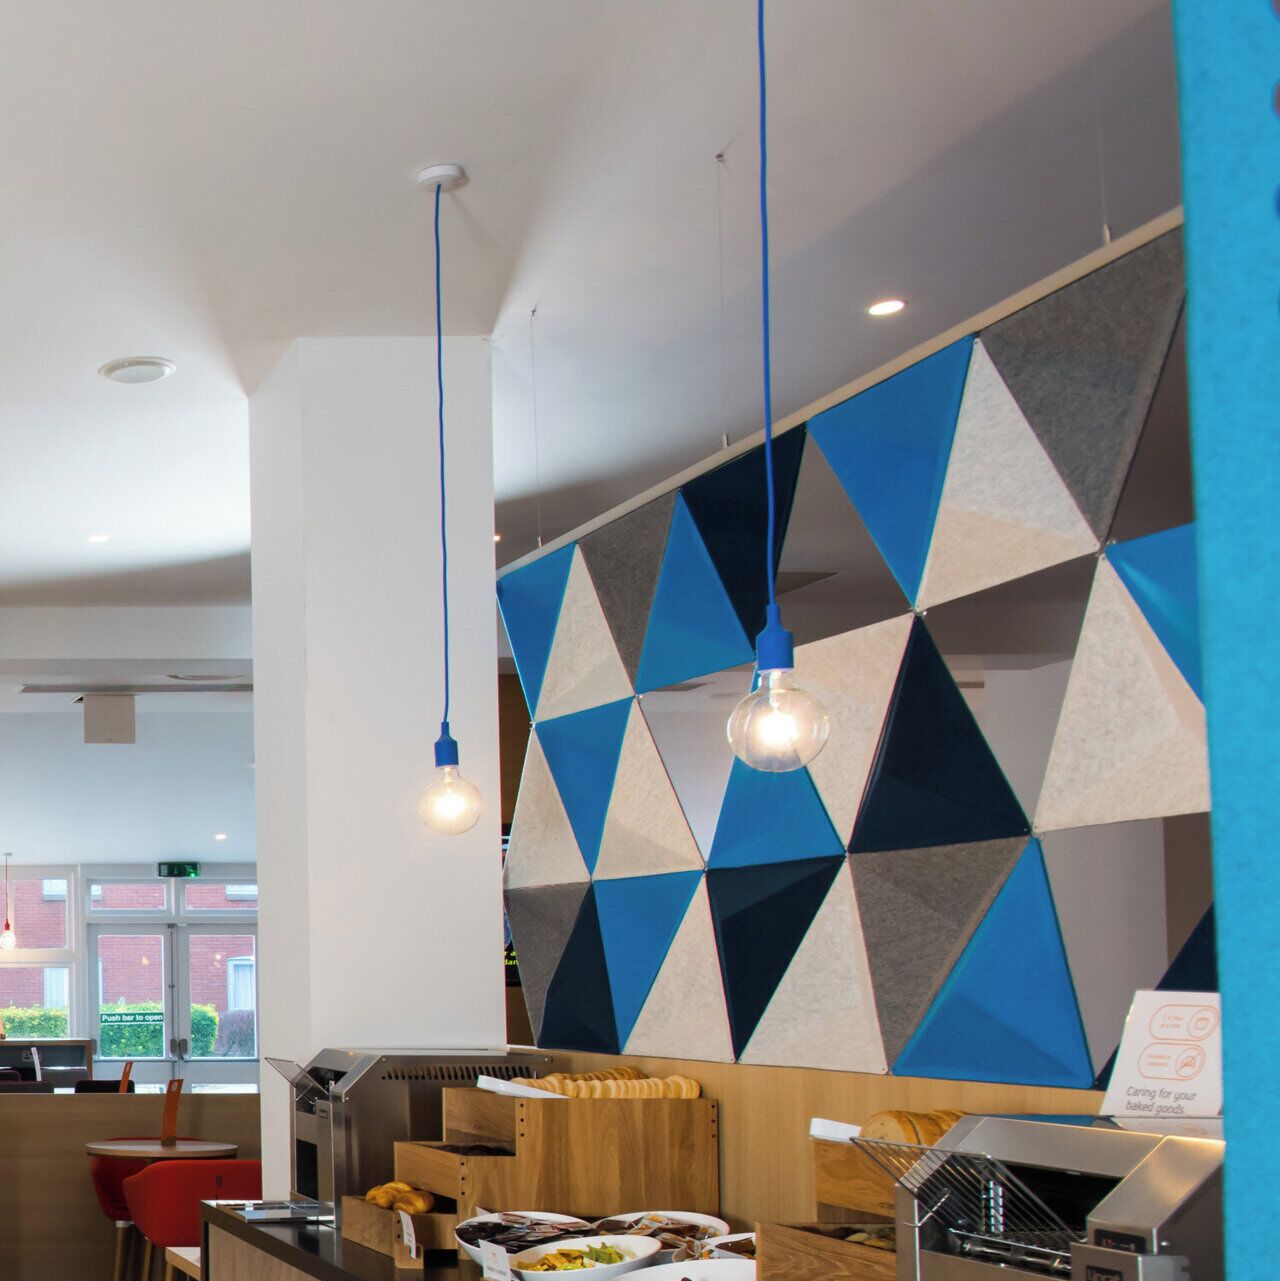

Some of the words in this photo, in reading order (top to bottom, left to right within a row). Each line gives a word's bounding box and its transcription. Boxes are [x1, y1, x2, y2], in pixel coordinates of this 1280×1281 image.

[101, 1014, 120, 1022] Push
[1126, 1086, 1157, 1101] Caring
[1158, 1087, 1173, 1099] for
[1173, 1091, 1198, 1103] your
[1125, 1100, 1156, 1113] baked
[1155, 1104, 1185, 1116] goods.
